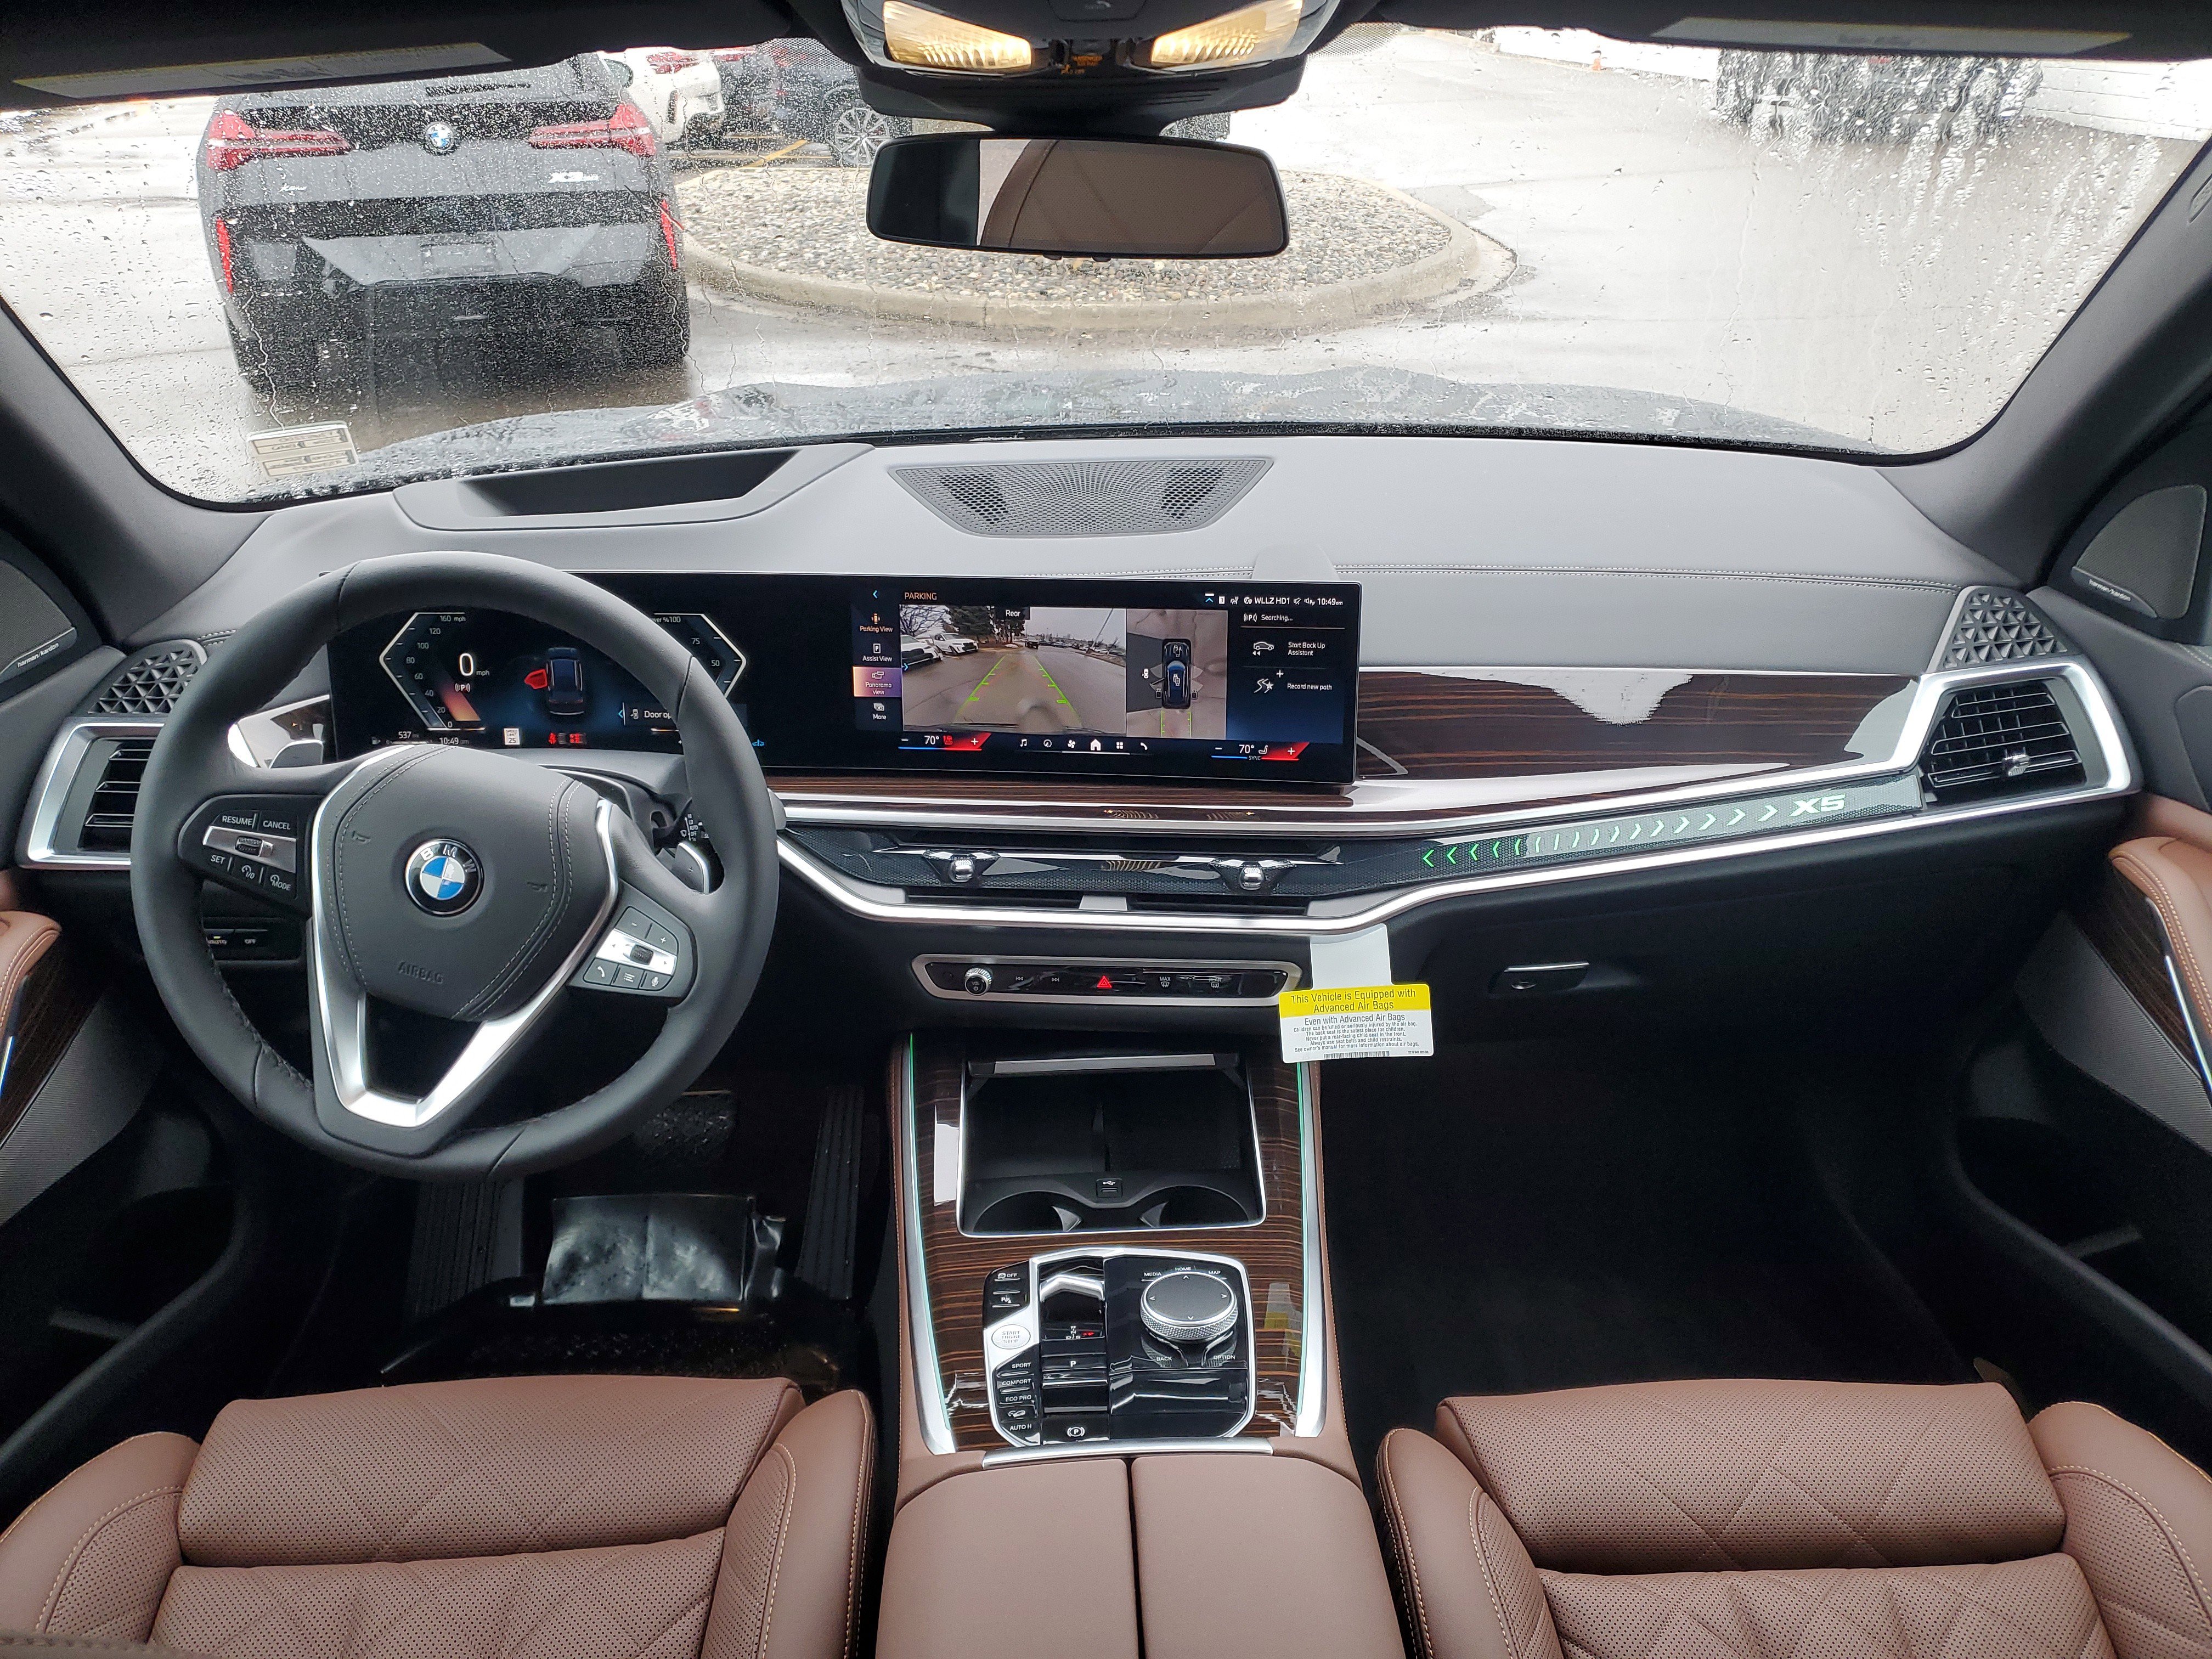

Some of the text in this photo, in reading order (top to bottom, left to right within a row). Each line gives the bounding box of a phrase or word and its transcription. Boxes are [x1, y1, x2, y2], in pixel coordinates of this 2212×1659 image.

[904, 592, 937, 601] PARKING
[18, 642, 59, 668] harman/kardon
[459, 653, 474, 676] 0
[924, 736, 940, 746] 70°
[1239, 744, 1255, 754] 70°
[1788, 793, 1846, 817] X5
[222, 815, 291, 831] RESUME CANCEL
[210, 855, 226, 865] SET
[420, 843, 477, 873] BMW
[272, 880, 291, 891] MODE
[397, 961, 444, 984] AIRBAG
[1291, 988, 1415, 1004] This Vehicle is Equipped with
[1313, 1001, 1394, 1013] Advanced Air Bags
[1304, 1018, 1321, 1026] Even
[1340, 1014, 1373, 1024] Advanced
[1375, 1013, 1385, 1022] Air
[1387, 1013, 1406, 1022] Bags
